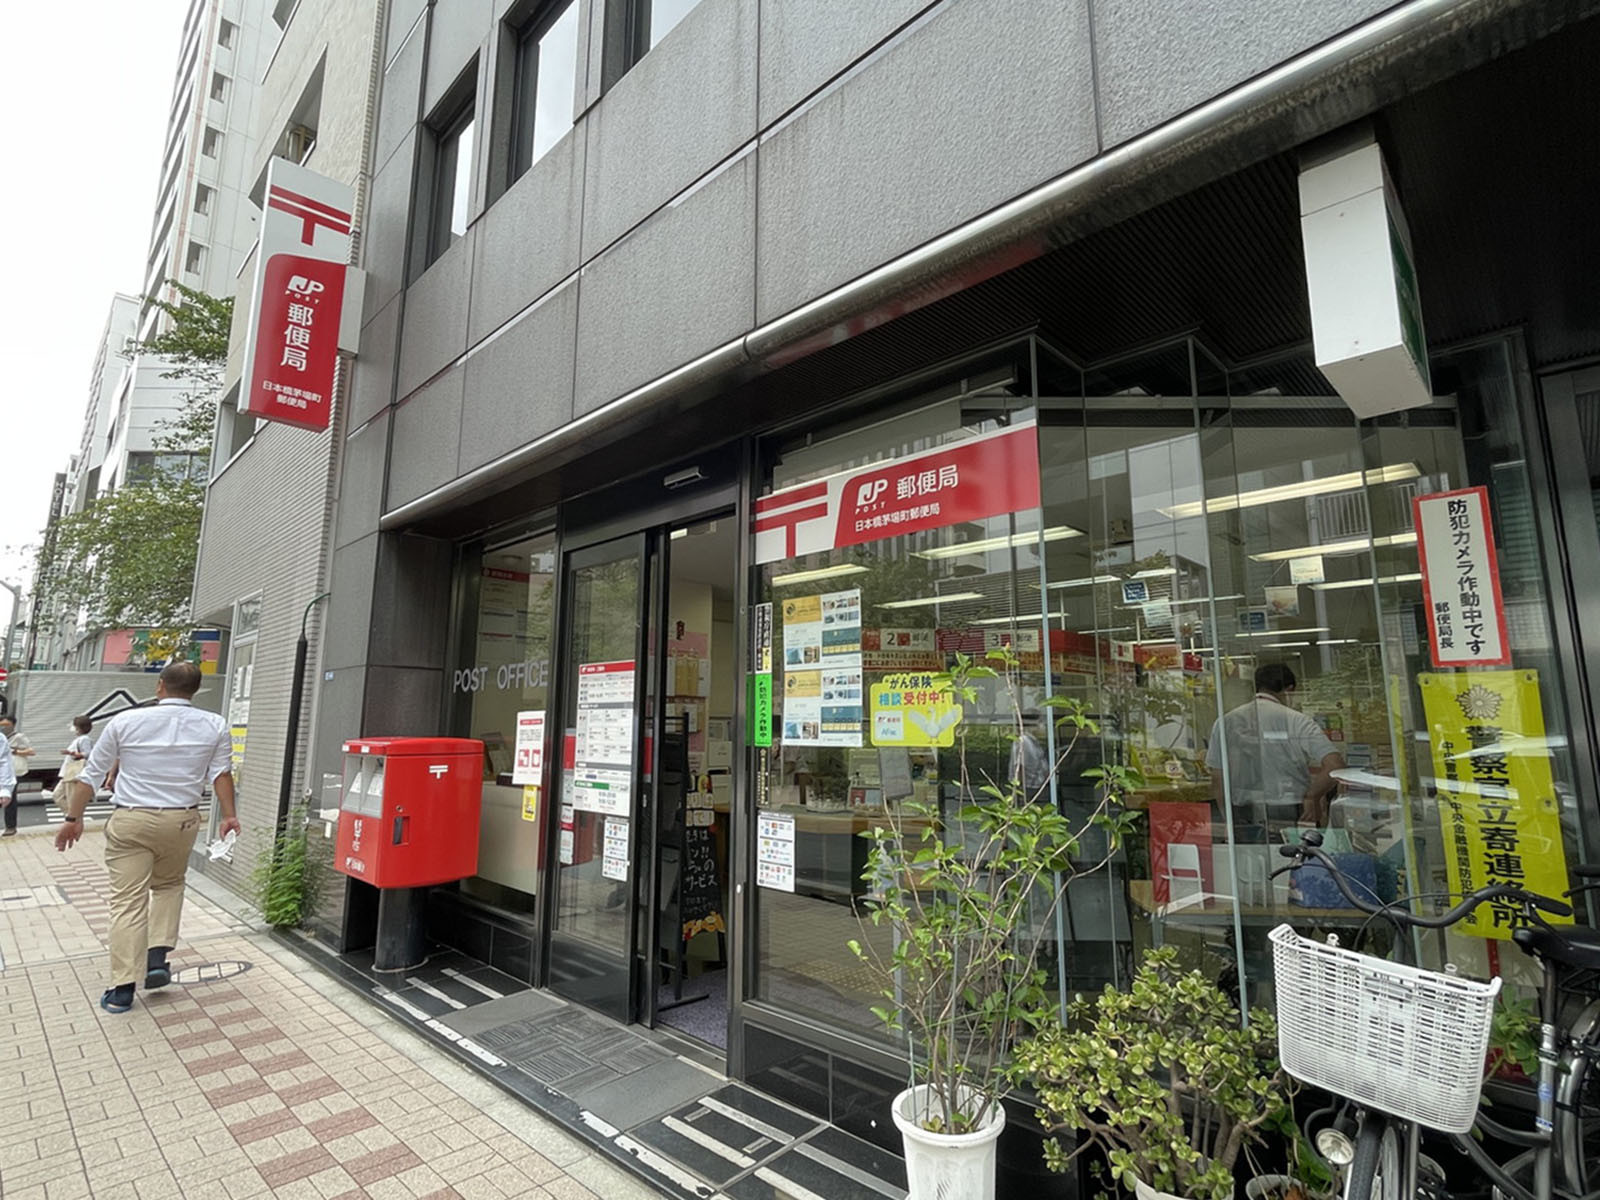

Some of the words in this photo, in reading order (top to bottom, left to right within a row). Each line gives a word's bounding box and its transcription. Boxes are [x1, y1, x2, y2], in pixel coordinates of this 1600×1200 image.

[280, 303, 314, 372] 郵便局
[262, 379, 323, 403] 日本橋茅場町
[276, 394, 308, 409] 郵便局
[51, 481, 64, 516] HOTEL
[897, 464, 959, 499] 郵便局
[855, 501, 886, 514] POST
[855, 502, 940, 532] 日本橋茅場町郵便局
[1448, 499, 1486, 655] 防犯カメラ作動中です
[1435, 601, 1454, 649] 郵便局長
[453, 666, 489, 693] POST
[497, 660, 549, 690] OFFICE
